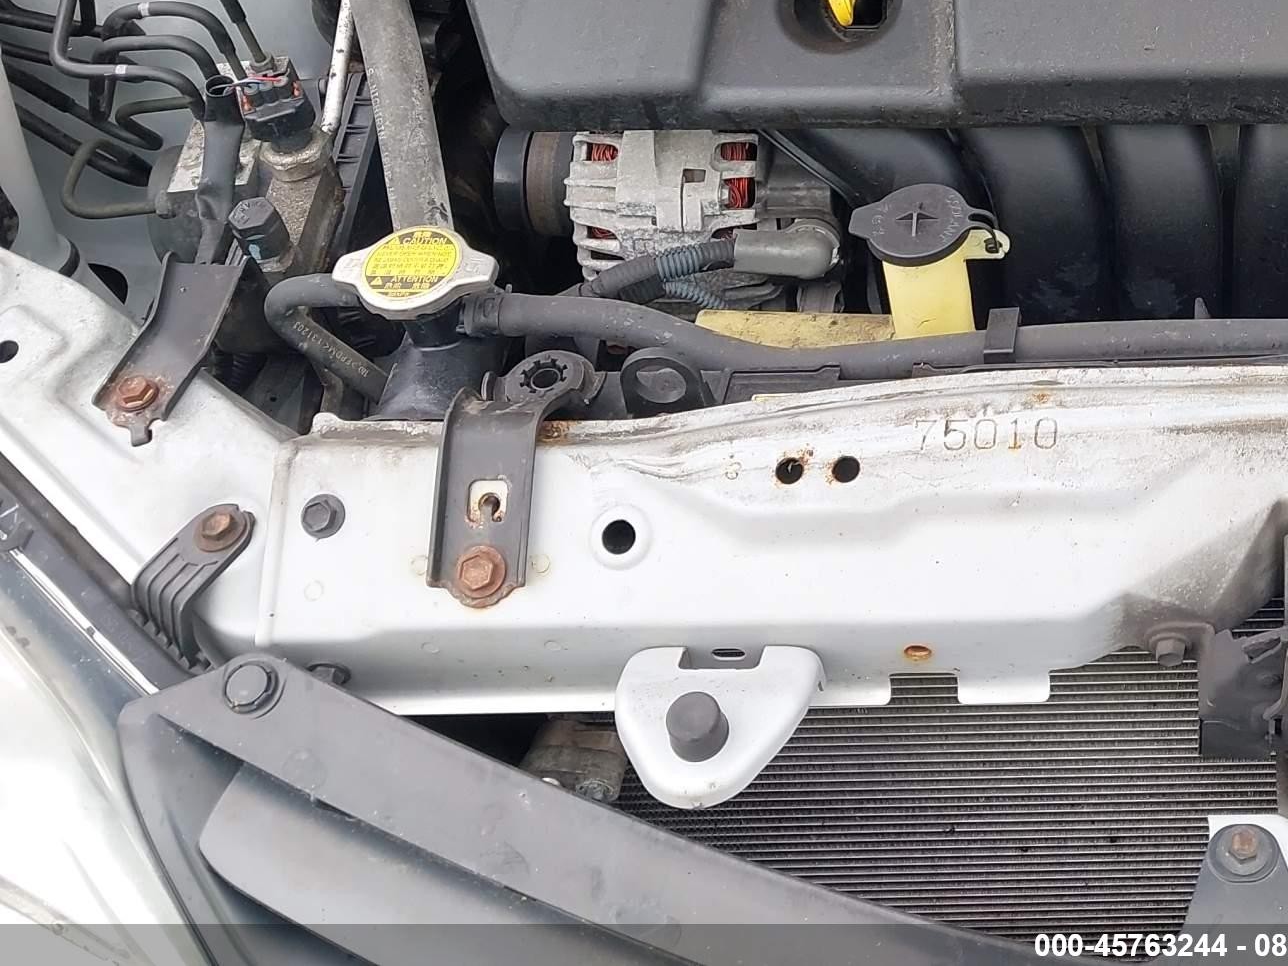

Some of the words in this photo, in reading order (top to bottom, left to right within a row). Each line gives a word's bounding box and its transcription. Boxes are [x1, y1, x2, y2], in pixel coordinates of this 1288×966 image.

[402, 237, 448, 245] CAUTION
[390, 275, 439, 283] ATTENTION
[914, 417, 1058, 451] 75010
